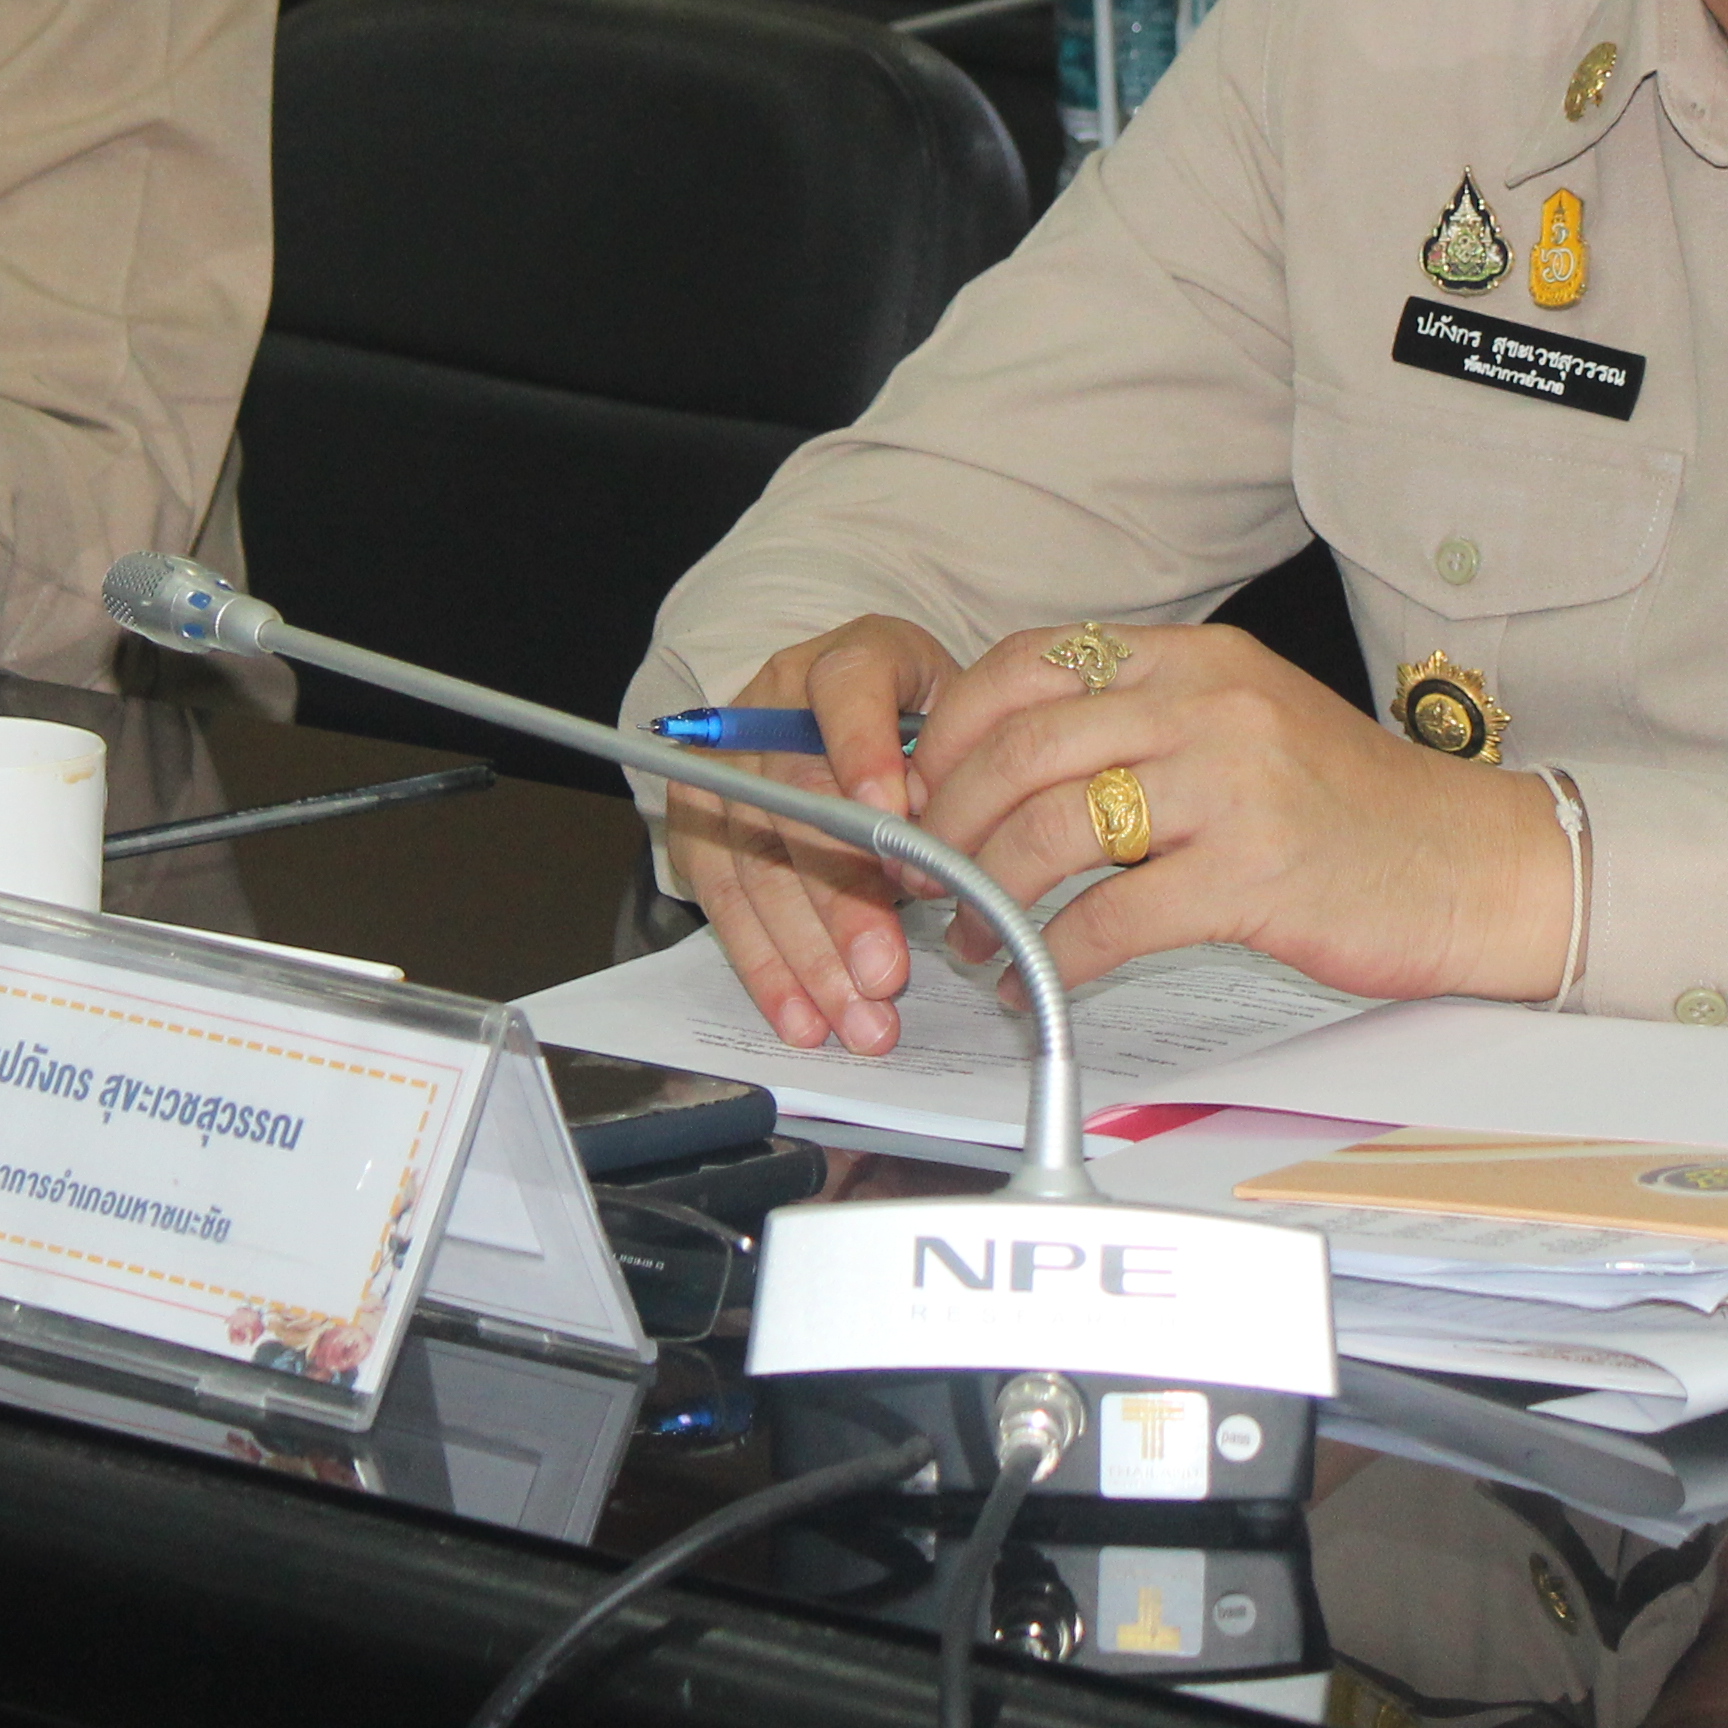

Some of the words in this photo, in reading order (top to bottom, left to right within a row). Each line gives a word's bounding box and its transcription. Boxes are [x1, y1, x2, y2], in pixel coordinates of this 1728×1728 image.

[1417, 311, 1482, 349] ปภังกร
[1463, 354, 1565, 396] พัฒนาการอำเภอ
[98, 1073, 305, 1152] สุขะเวชสุวรรณ
[913, 1234, 1179, 1298] NPE
